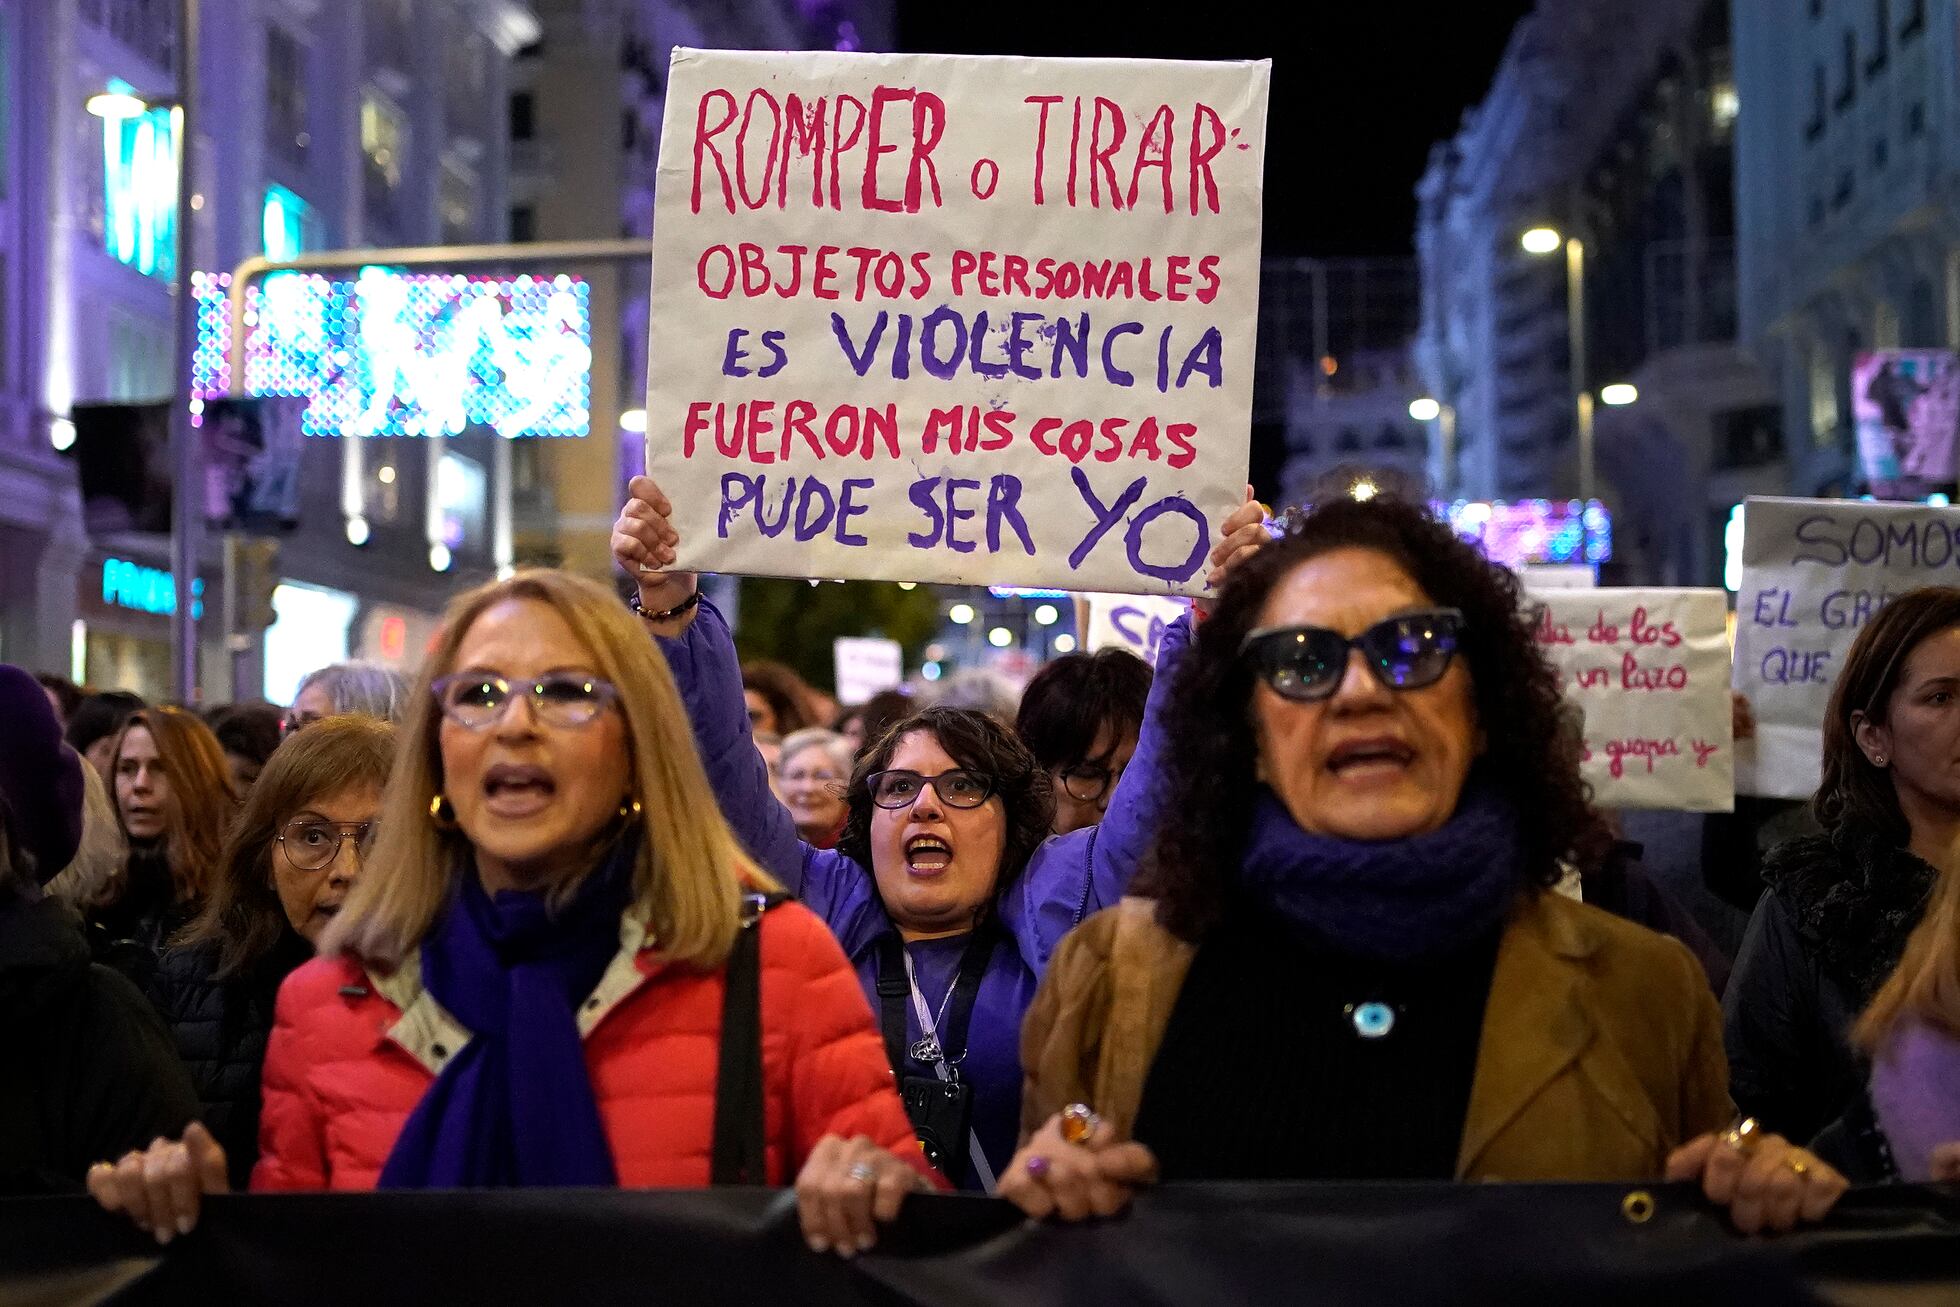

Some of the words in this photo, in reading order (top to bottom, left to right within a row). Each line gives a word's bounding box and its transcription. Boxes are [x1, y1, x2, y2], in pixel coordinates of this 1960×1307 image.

[691, 85, 946, 215] ROMPER
[1025, 95, 1228, 216] TIRAR
[697, 243, 931, 302] OBJETOS
[951, 249, 1221, 304] PERSONALES
[722, 328, 789, 378] ES
[831, 305, 1223, 392] VIOLENCIA
[684, 400, 900, 464] FUERON
[922, 405, 1016, 456] MIS
[1029, 417, 1198, 469] COSAS
[717, 472, 875, 547] PUDE
[907, 474, 1036, 556] SER
[1069, 467, 1211, 583] YO
[1792, 515, 1960, 568] SOMO
[1588, 608, 1618, 644] de
[1631, 606, 1681, 648] los
[1754, 586, 1798, 628] EL
[1576, 665, 1609, 689] un
[1622, 651, 1687, 690] lazo
[1761, 646, 1831, 685] QUE
[1605, 737, 1680, 779] guapa
[1690, 738, 1719, 768] y
